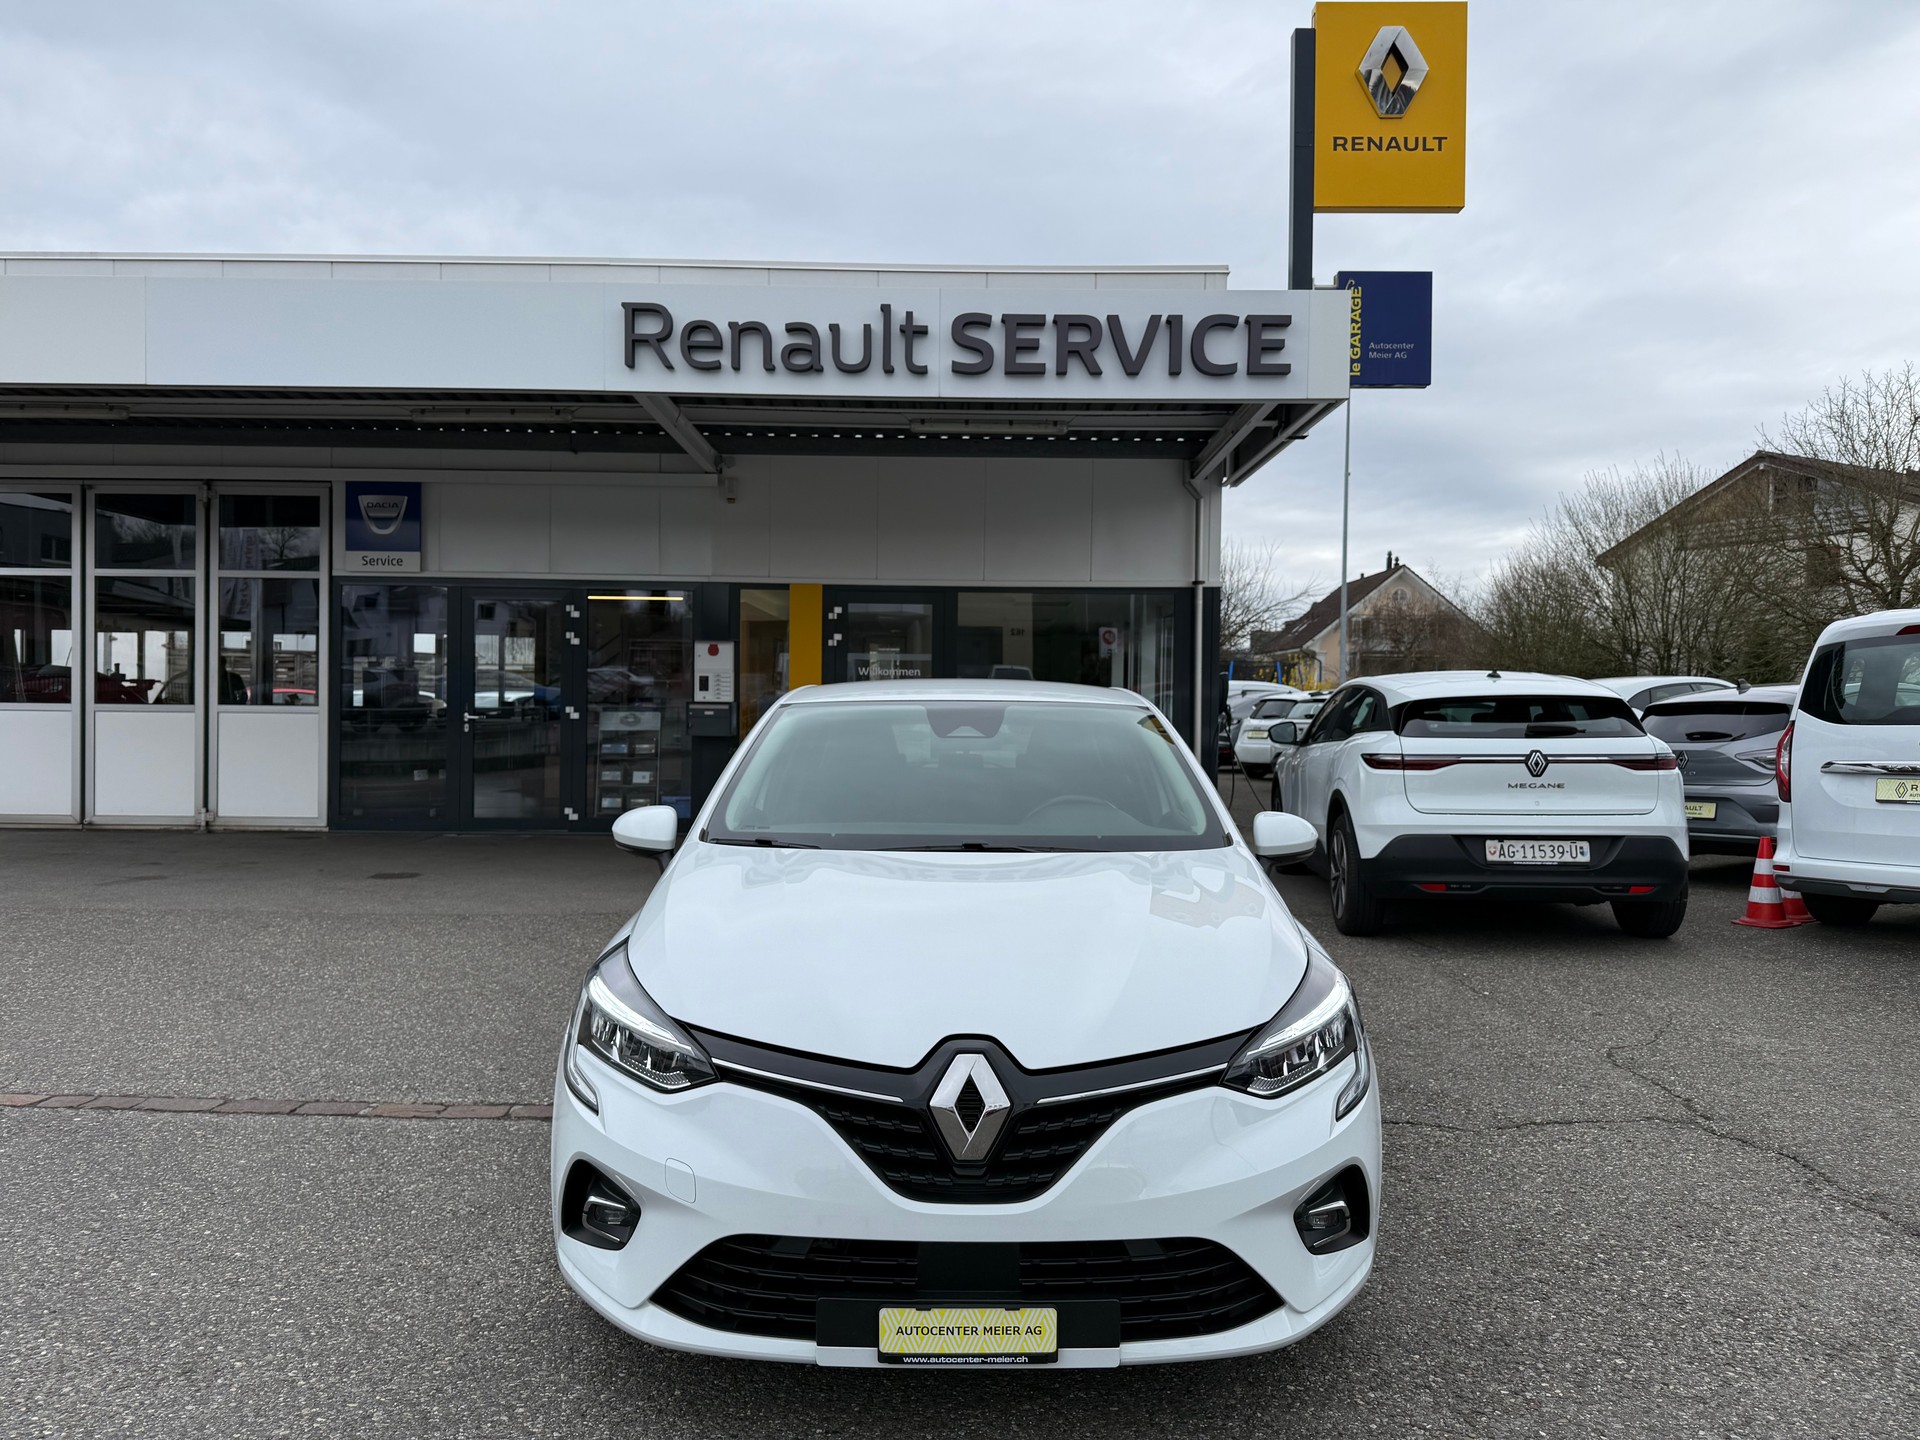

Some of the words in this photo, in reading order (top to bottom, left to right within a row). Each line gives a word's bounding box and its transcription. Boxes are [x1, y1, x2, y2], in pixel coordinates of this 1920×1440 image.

[1332, 136, 1448, 151] RENAULT
[1350, 286, 1362, 359] GARAGE
[621, 301, 929, 374] Renault
[950, 312, 1293, 377] SERVICE
[1368, 351, 1392, 359] Meier
[1394, 351, 1408, 359] AG
[1350, 363, 1361, 376] le
[361, 555, 404, 567] Service
[858, 666, 921, 676] Willkommen
[896, 1325, 979, 1336] AUTOCENTER
[983, 1325, 1021, 1336] MEIER
[1025, 1325, 1042, 1336] AG
[903, 1355, 1029, 1363] www.autocenter-meier.ch
